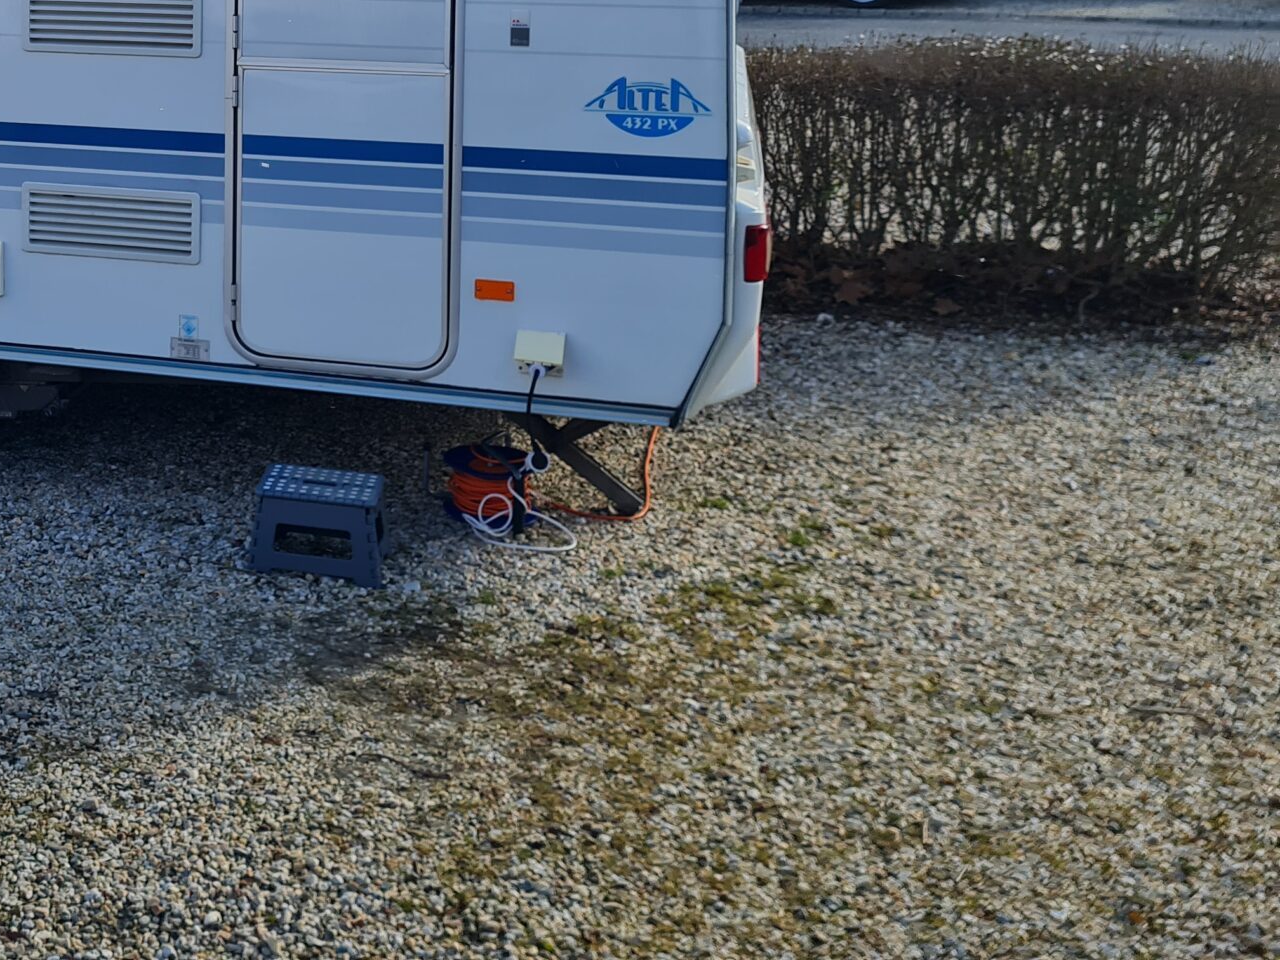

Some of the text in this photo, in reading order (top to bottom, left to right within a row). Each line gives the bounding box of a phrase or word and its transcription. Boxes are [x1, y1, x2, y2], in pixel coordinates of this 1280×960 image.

[584, 76, 712, 113] ALTEA
[623, 117, 678, 130] 432 PX
